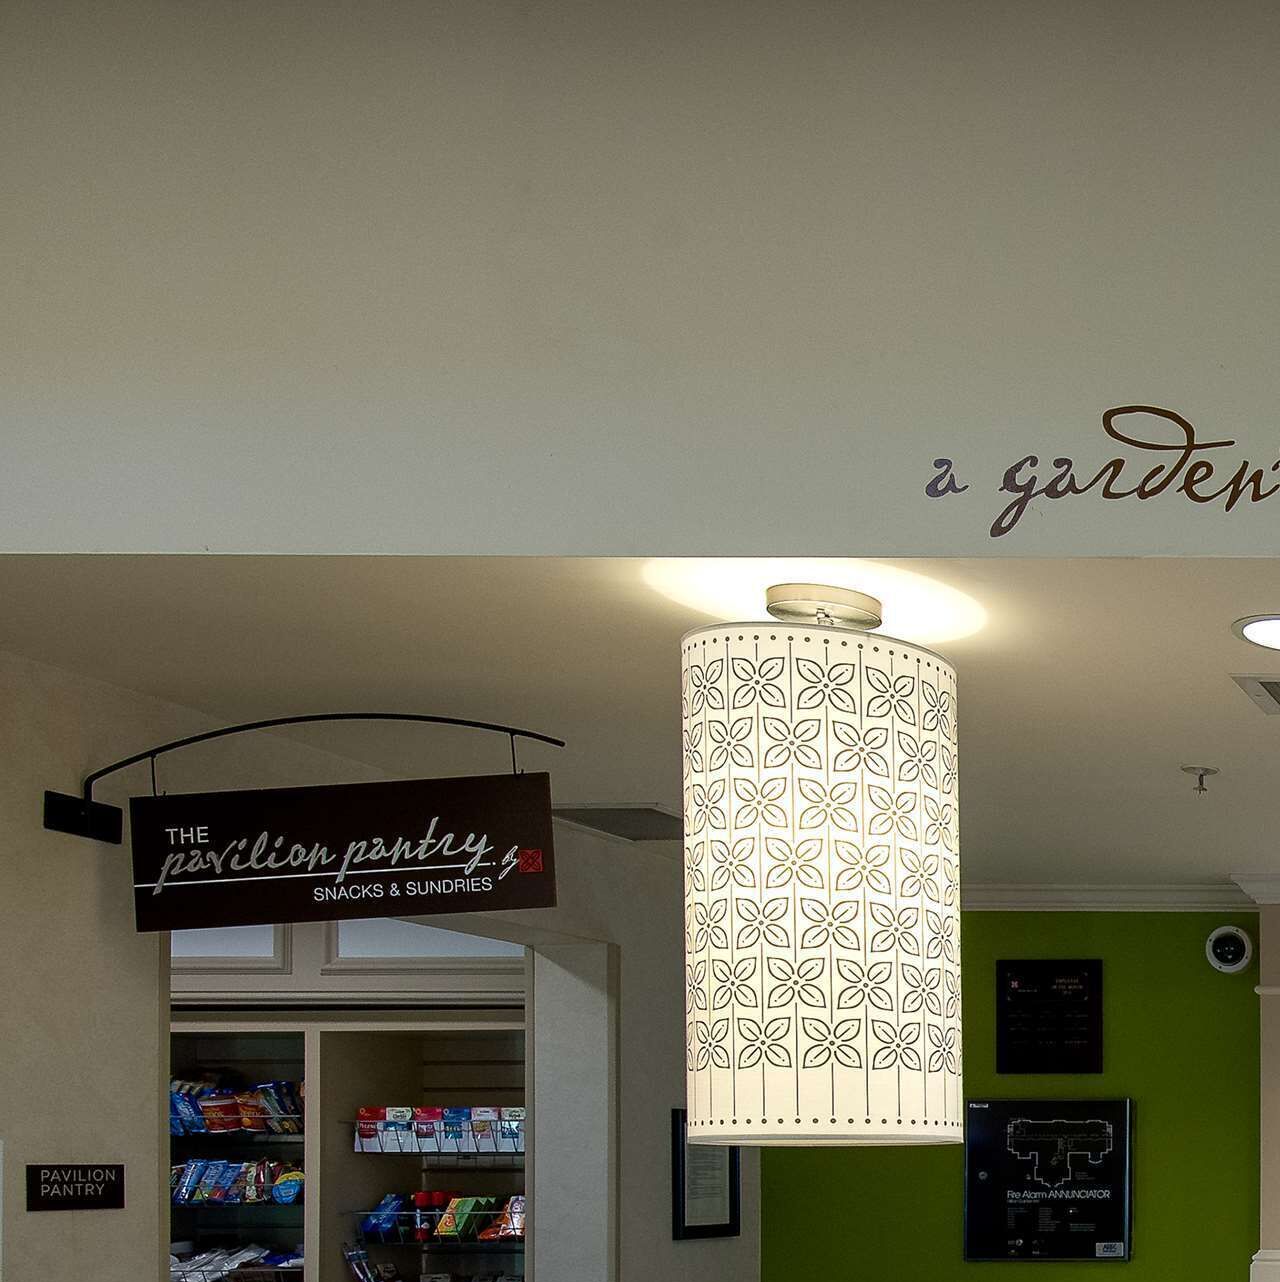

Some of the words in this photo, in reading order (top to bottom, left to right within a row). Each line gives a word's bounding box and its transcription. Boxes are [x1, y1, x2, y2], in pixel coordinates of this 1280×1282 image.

[924, 456, 968, 498] a
[165, 826, 210, 845] THE
[152, 831, 336, 896] pavilion
[313, 883, 384, 902] SNACKS
[390, 882, 401, 897] &
[405, 877, 494, 896] SUNDRIES
[40, 1169, 116, 1182] PAVILION
[40, 1183, 105, 1197] PANTRY
